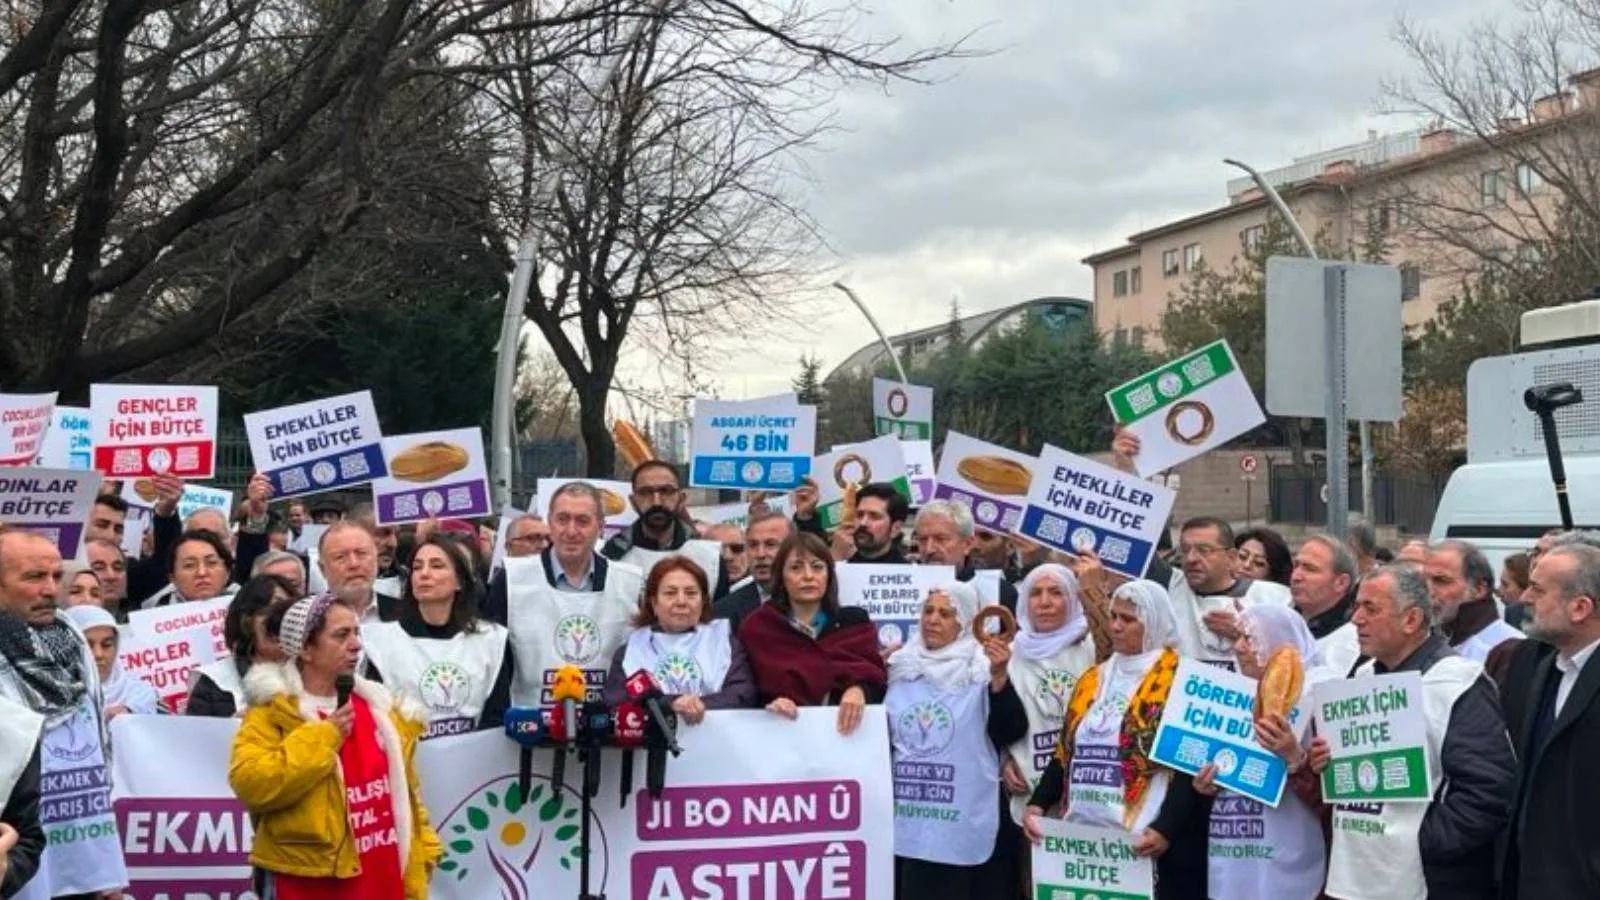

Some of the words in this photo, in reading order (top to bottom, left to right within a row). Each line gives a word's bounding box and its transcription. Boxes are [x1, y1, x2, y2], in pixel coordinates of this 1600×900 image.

[117, 397, 197, 416] GENÇLER
[109, 422, 147, 441] İÇİN
[150, 418, 204, 437] BÜTÇE
[263, 404, 358, 441] EMEKLİLER
[711, 414, 757, 428] ASGARİ
[758, 415, 797, 428] ÜCRET
[269, 439, 305, 462] İÇİN
[307, 426, 362, 452] BÜTÇE
[720, 434, 748, 451] 46
[753, 429, 789, 452] BİN
[0, 478, 77, 493] DINLAR
[1052, 466, 1154, 509] EMEKLİLER
[1, 496, 74, 518] BÜTÇE
[1046, 487, 1082, 513] İÇİN
[1083, 503, 1146, 530] BÜTÇE
[869, 573, 912, 585] EKMEK
[863, 589, 879, 600] VE
[881, 588, 920, 601] BARIŞ
[1184, 701, 1224, 731] İÇİN
[1322, 698, 1370, 723] EKMEK
[1373, 685, 1408, 713] İÇİN
[1341, 721, 1391, 749] BÜTÇE
[646, 800, 671, 829] JI
[685, 798, 732, 827] BO
[743, 793, 817, 825] NAN
[829, 784, 851, 820] Û
[1045, 836, 1100, 857] EKMEK
[1102, 837, 1138, 861] İÇİN
[1065, 860, 1121, 885] BÜTÇE
